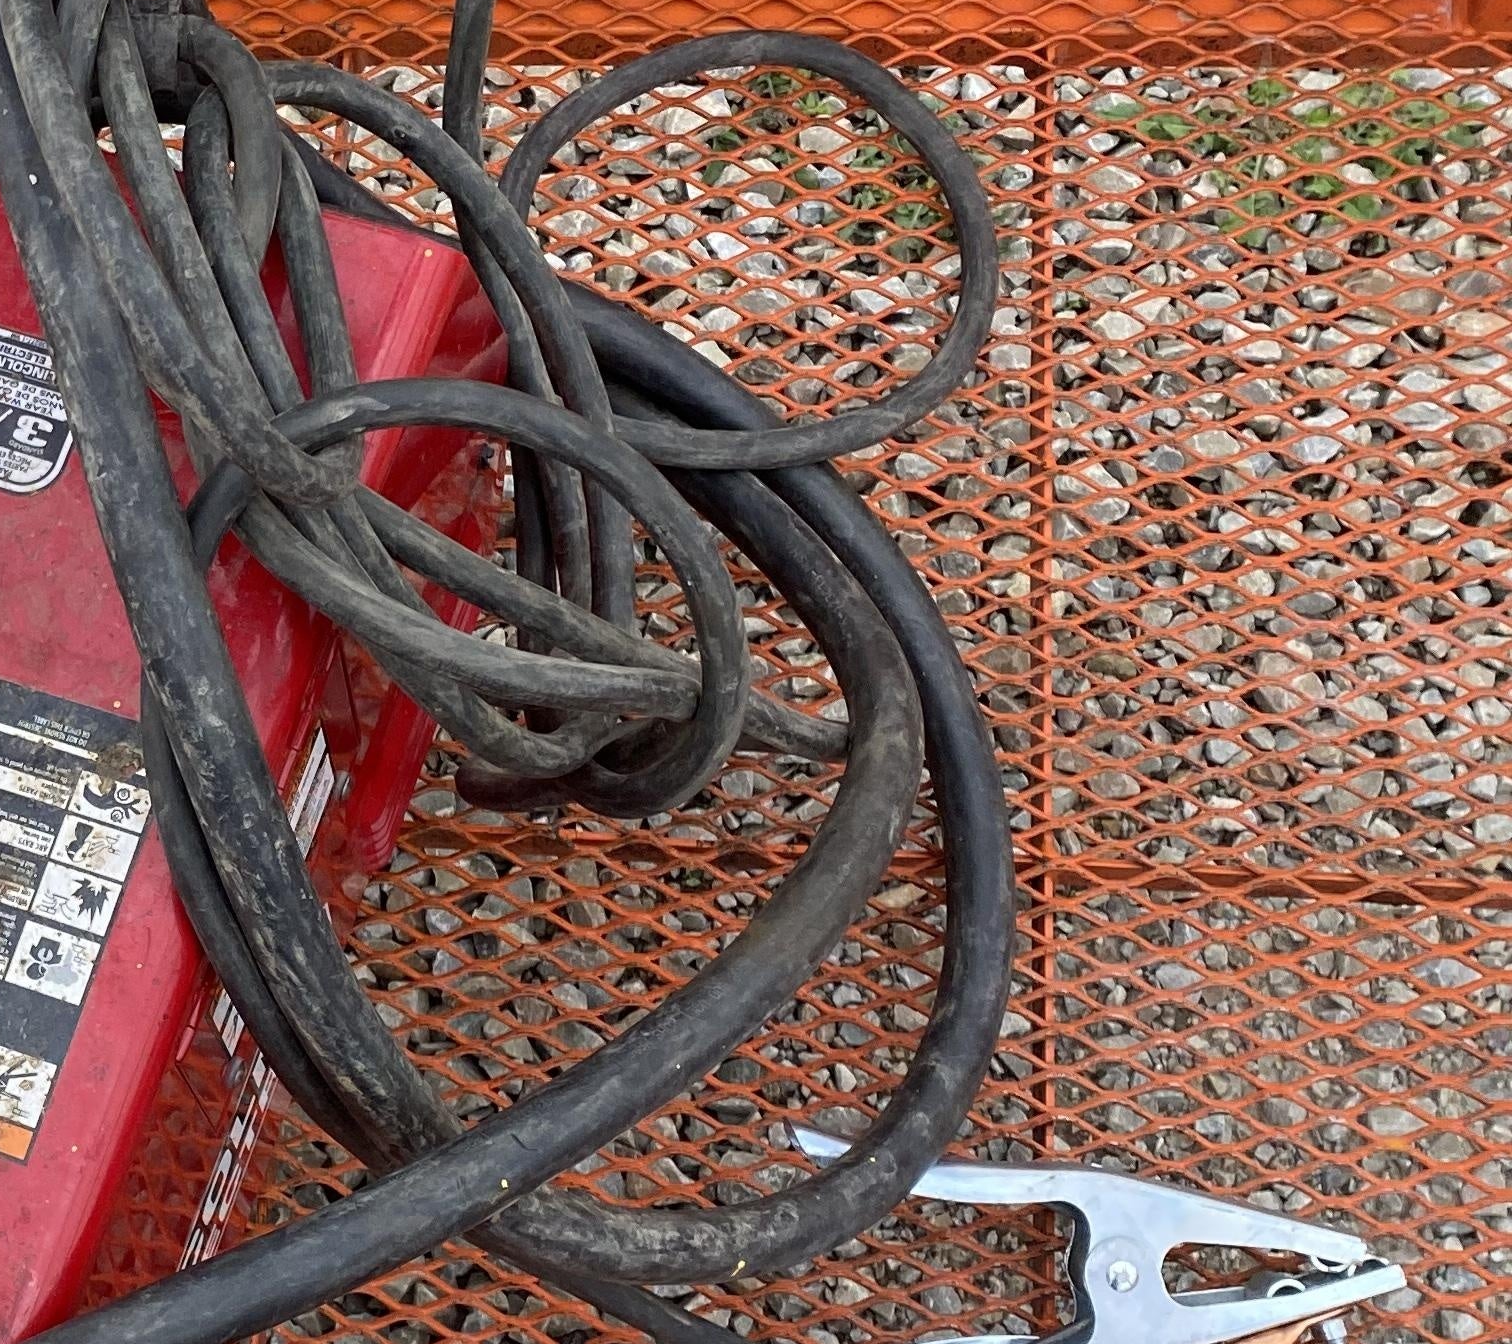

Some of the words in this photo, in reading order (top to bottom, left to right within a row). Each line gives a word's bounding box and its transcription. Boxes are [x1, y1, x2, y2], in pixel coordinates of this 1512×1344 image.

[21, 383, 36, 393] DE
[14, 390, 30, 400] DE
[24, 401, 54, 415] YEAR
[9, 412, 56, 449] 3
[2, 459, 29, 472] PARTES
